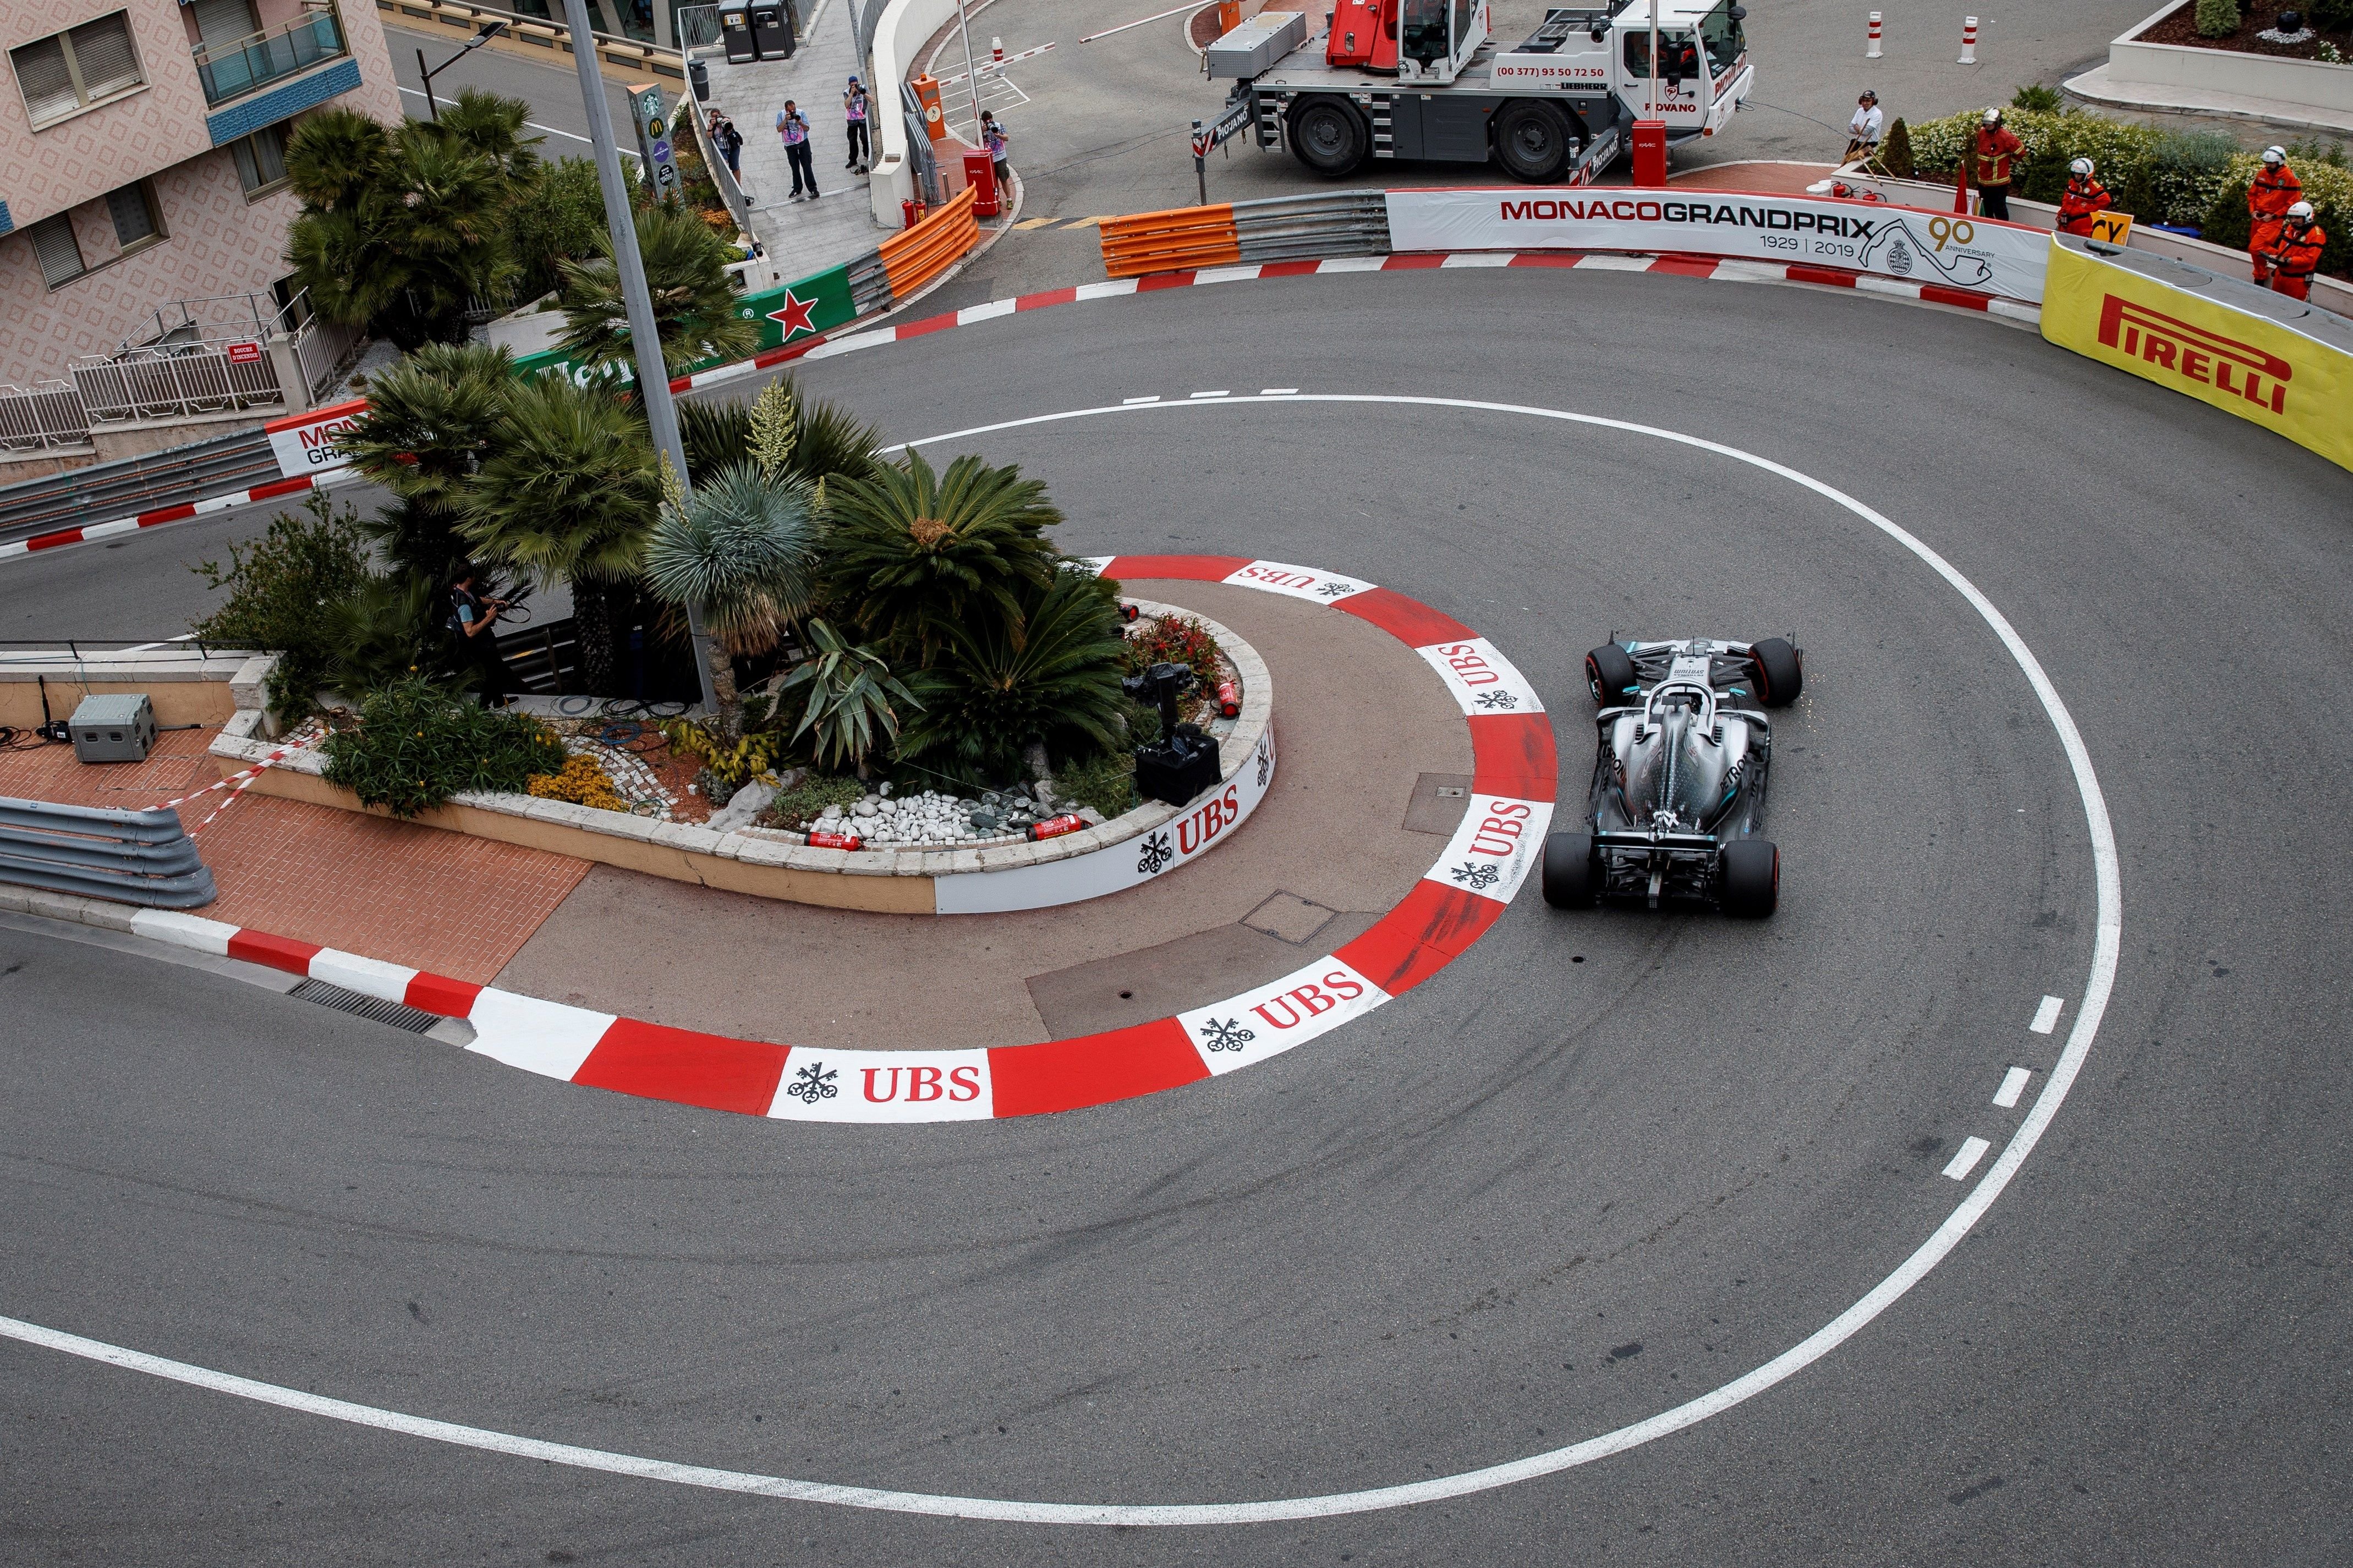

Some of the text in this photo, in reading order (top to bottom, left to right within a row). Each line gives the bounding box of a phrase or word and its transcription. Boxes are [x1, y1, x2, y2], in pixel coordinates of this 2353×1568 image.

[1498, 67, 1513, 76] (00
[1517, 68, 1539, 77] 377)
[1218, 110, 1248, 140] PIOVANO
[1645, 103, 1696, 112] POVANO
[1593, 139, 1617, 172] PIOVANO
[1760, 235, 1798, 250] 1929
[1815, 241, 1854, 257] 2019
[1929, 217, 1974, 252] 90
[1945, 244, 1995, 259] ANNIVERSARY
[2097, 293, 2293, 415] PIRELLI
[1238, 566, 1315, 589] UBS
[1437, 644, 1499, 686] UBS
[1719, 754, 1747, 793] PETRO
[1177, 784, 1238, 855] UBS
[1469, 801, 1531, 856] UBS
[1250, 970, 1364, 1030] UBS
[862, 1066, 980, 1103] UBS
